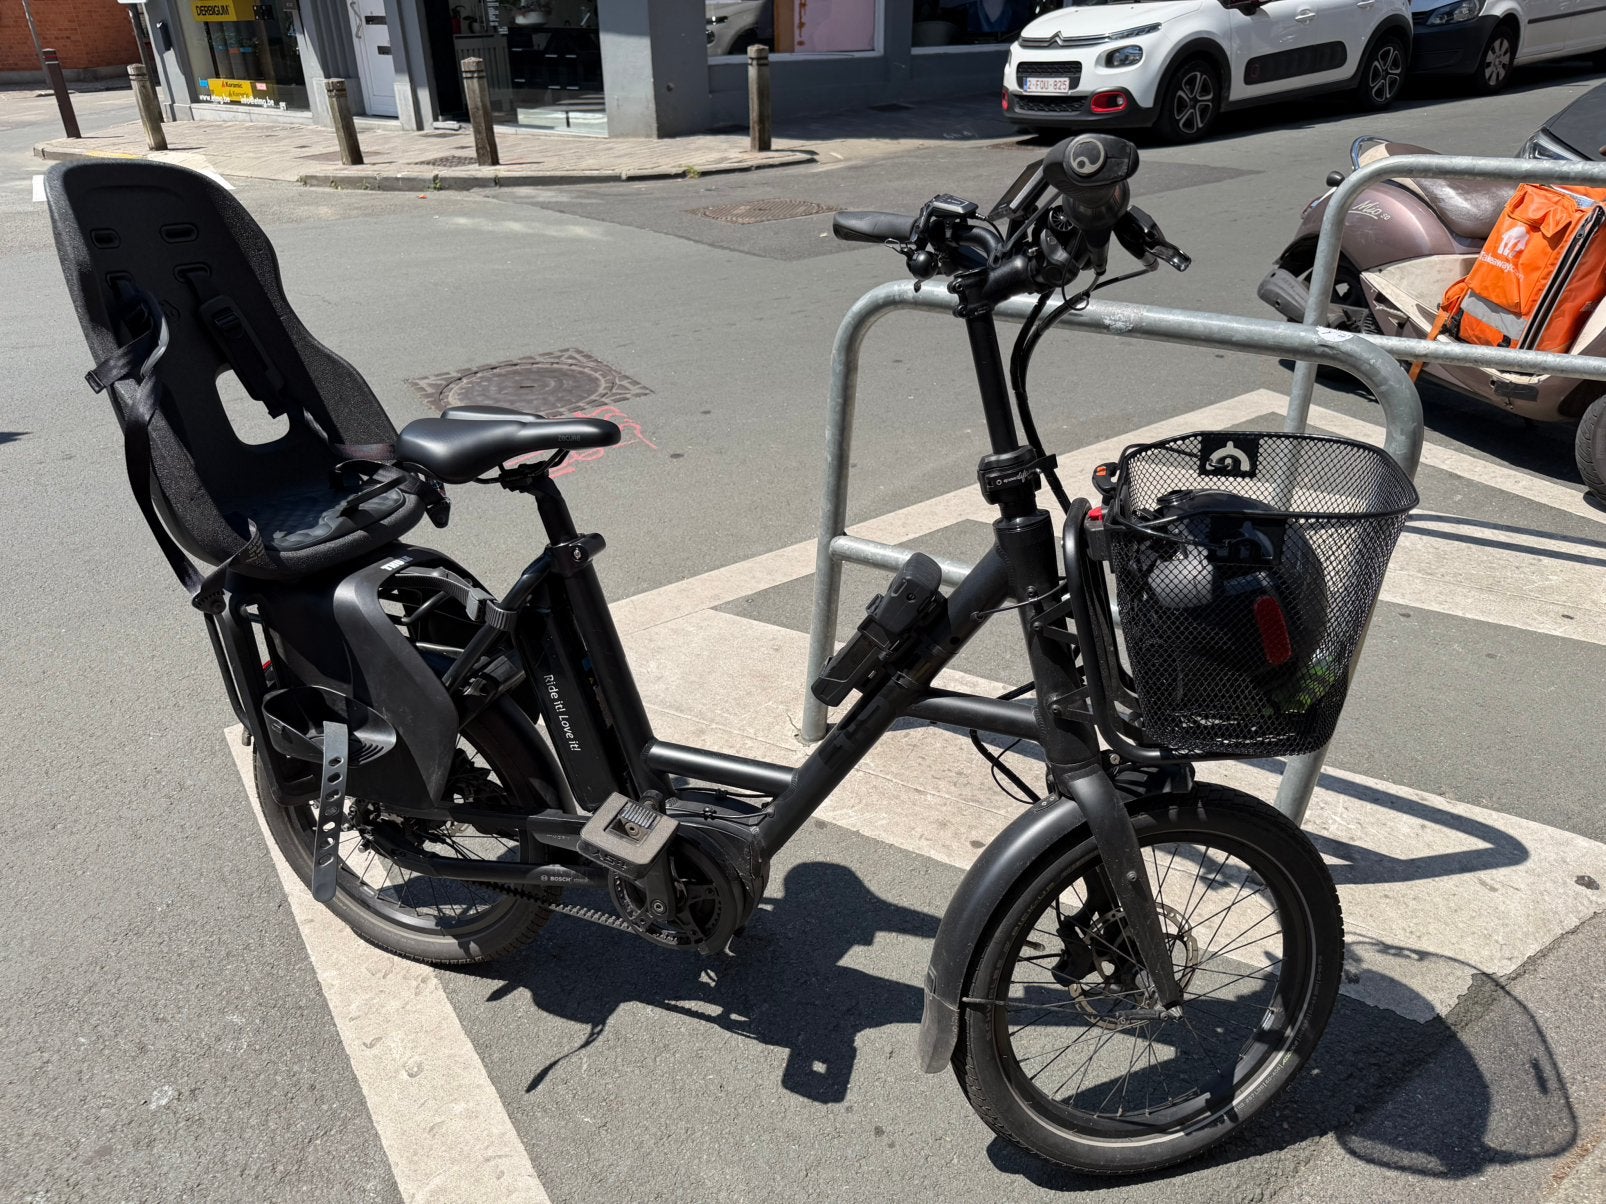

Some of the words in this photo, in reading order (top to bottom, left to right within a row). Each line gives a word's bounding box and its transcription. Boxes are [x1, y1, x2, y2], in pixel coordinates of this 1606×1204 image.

[196, 5, 230, 16] DERBIGUM
[544, 674, 559, 699] Ride
[553, 700, 566, 712] it!
[559, 715, 574, 739] Love
[568, 740, 581, 751] it!
